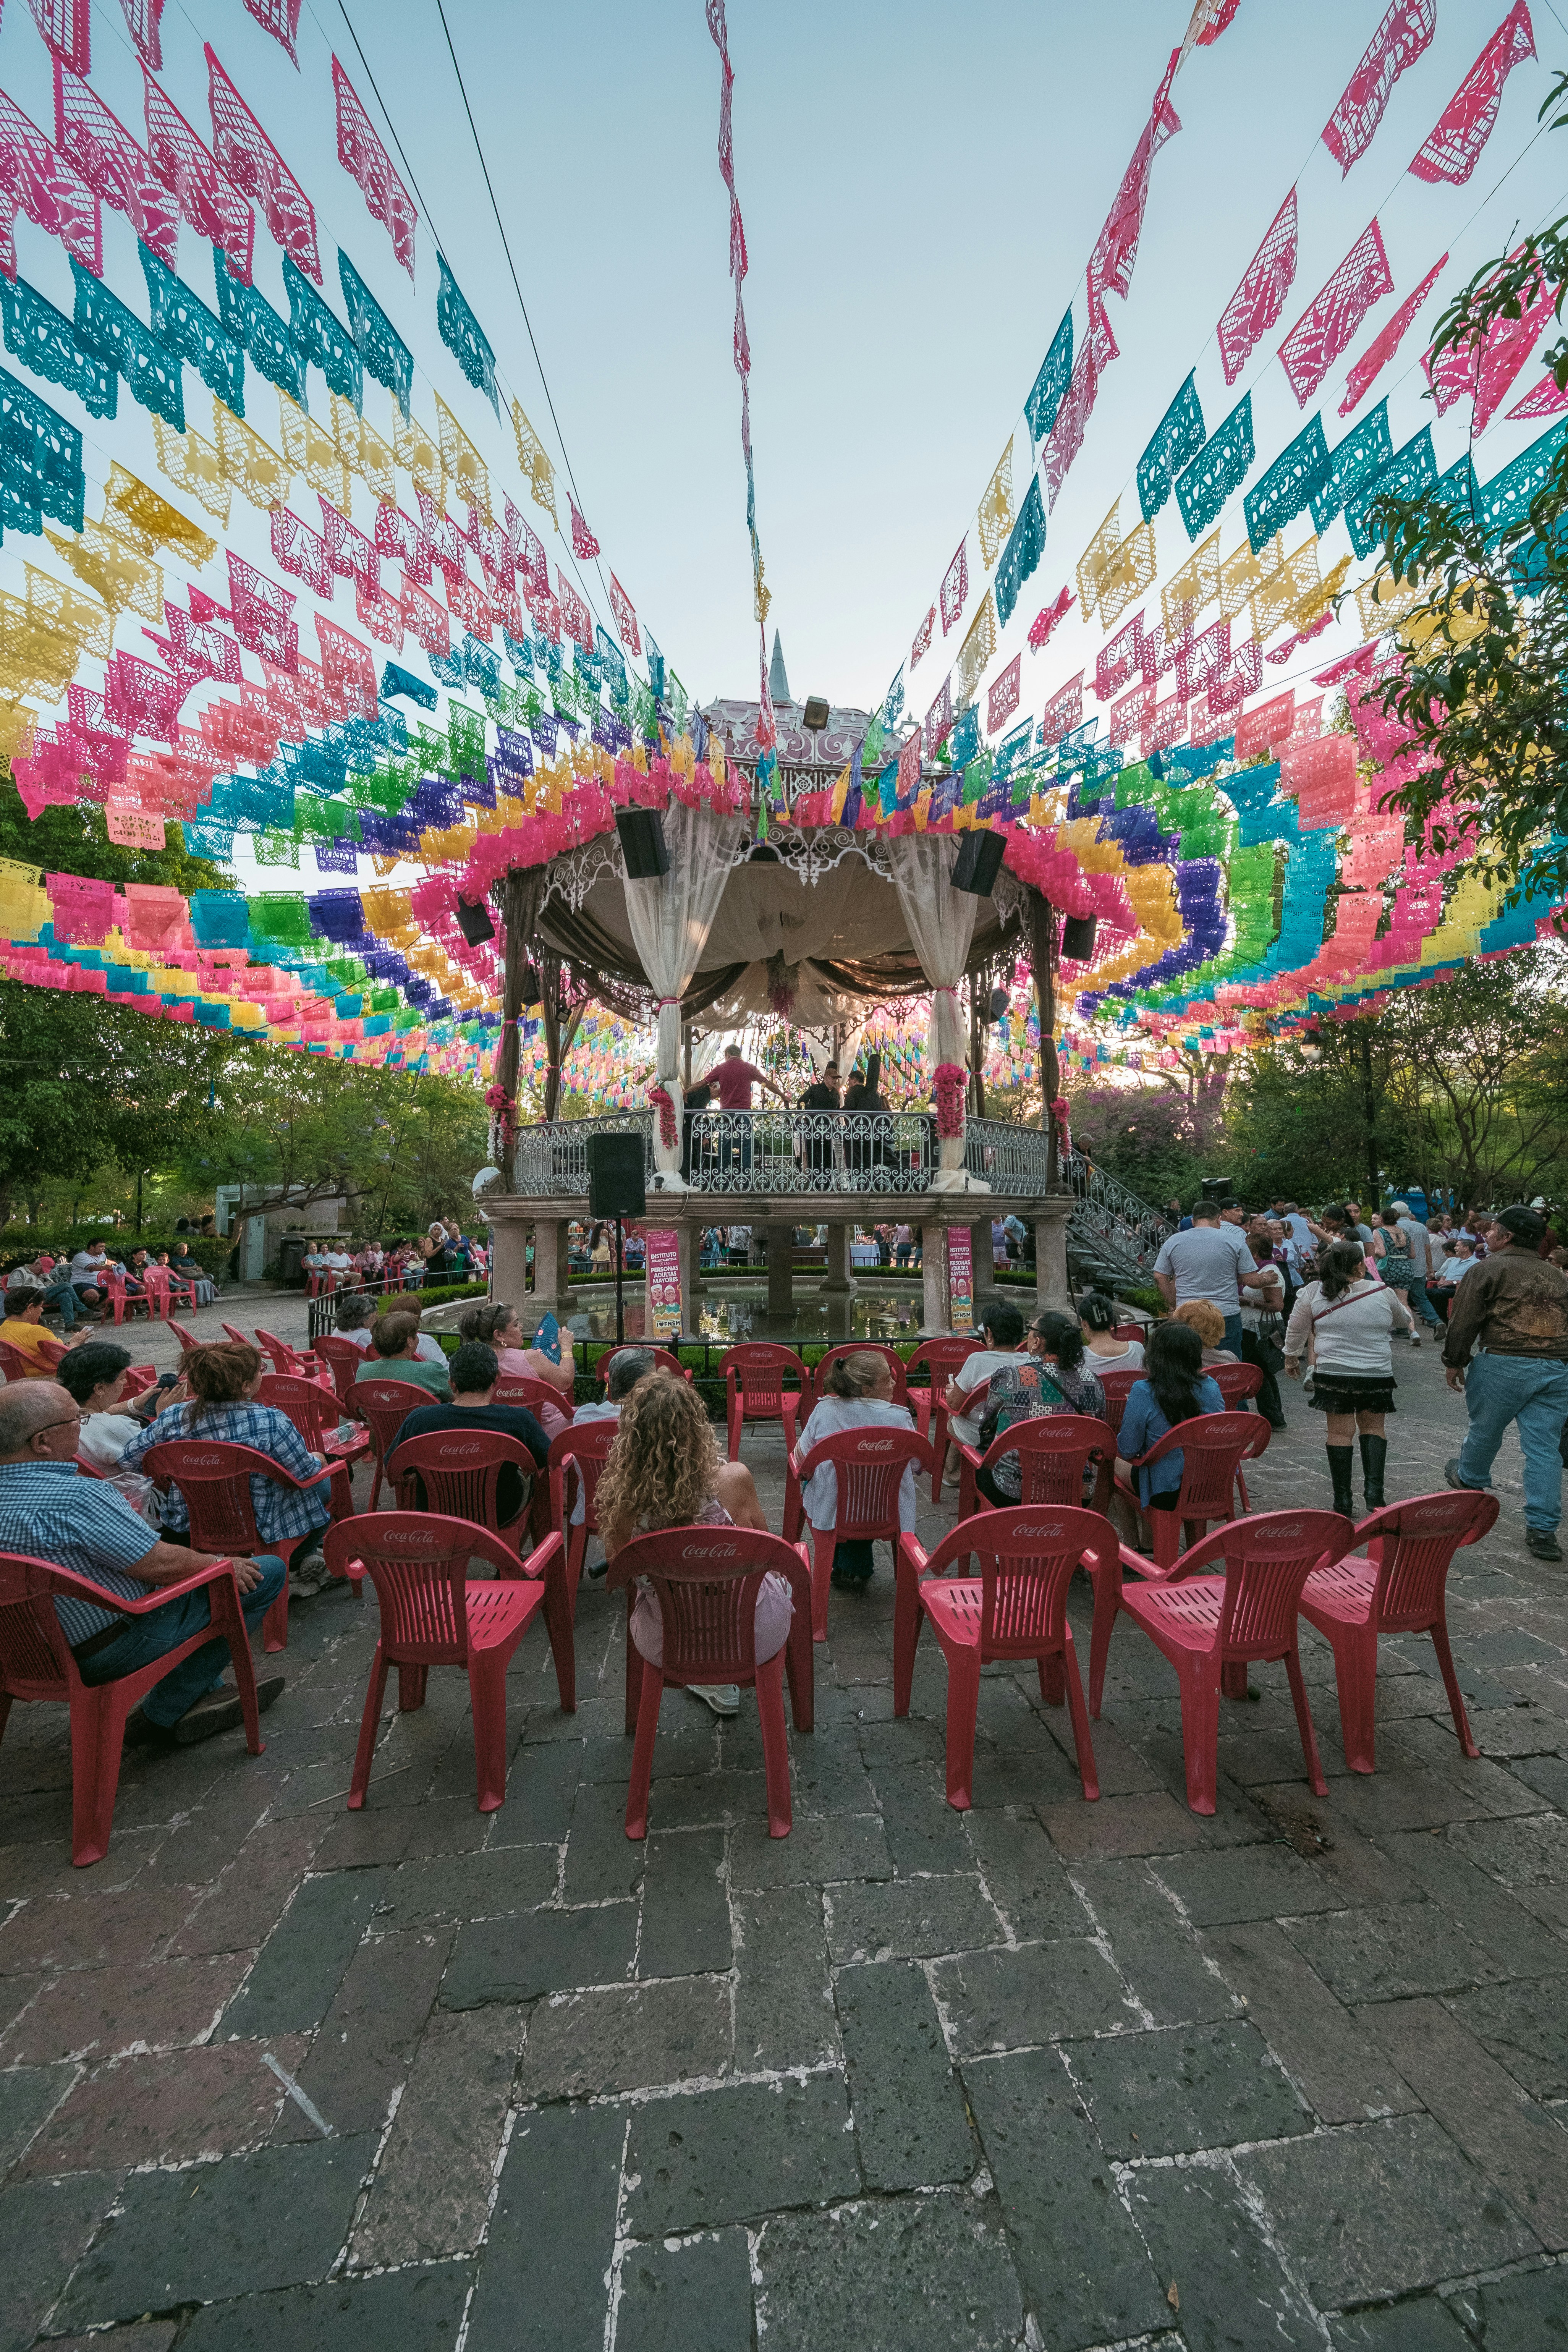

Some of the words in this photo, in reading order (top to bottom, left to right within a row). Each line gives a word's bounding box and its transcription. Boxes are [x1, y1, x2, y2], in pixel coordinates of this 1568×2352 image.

[651, 1251, 676, 1259] INSTITUTO
[496, 1388, 524, 1397] Coca-Cola
[1039, 1428, 1074, 1437] Coca-Cola
[1206, 1424, 1239, 1433] Coca-Cola
[440, 1442, 480, 1455] Coca-Cola
[858, 1439, 894, 1450] Coca-Cola
[183, 1454, 220, 1465] Coca-Cola
[1415, 1504, 1458, 1517] Coca-Cola
[1012, 1523, 1066, 1536] Coca-Cola
[1255, 1524, 1305, 1538] Coca-Cola
[384, 1530, 435, 1542] Coca-Cola
[682, 1543, 738, 1558] Coca-Cola
